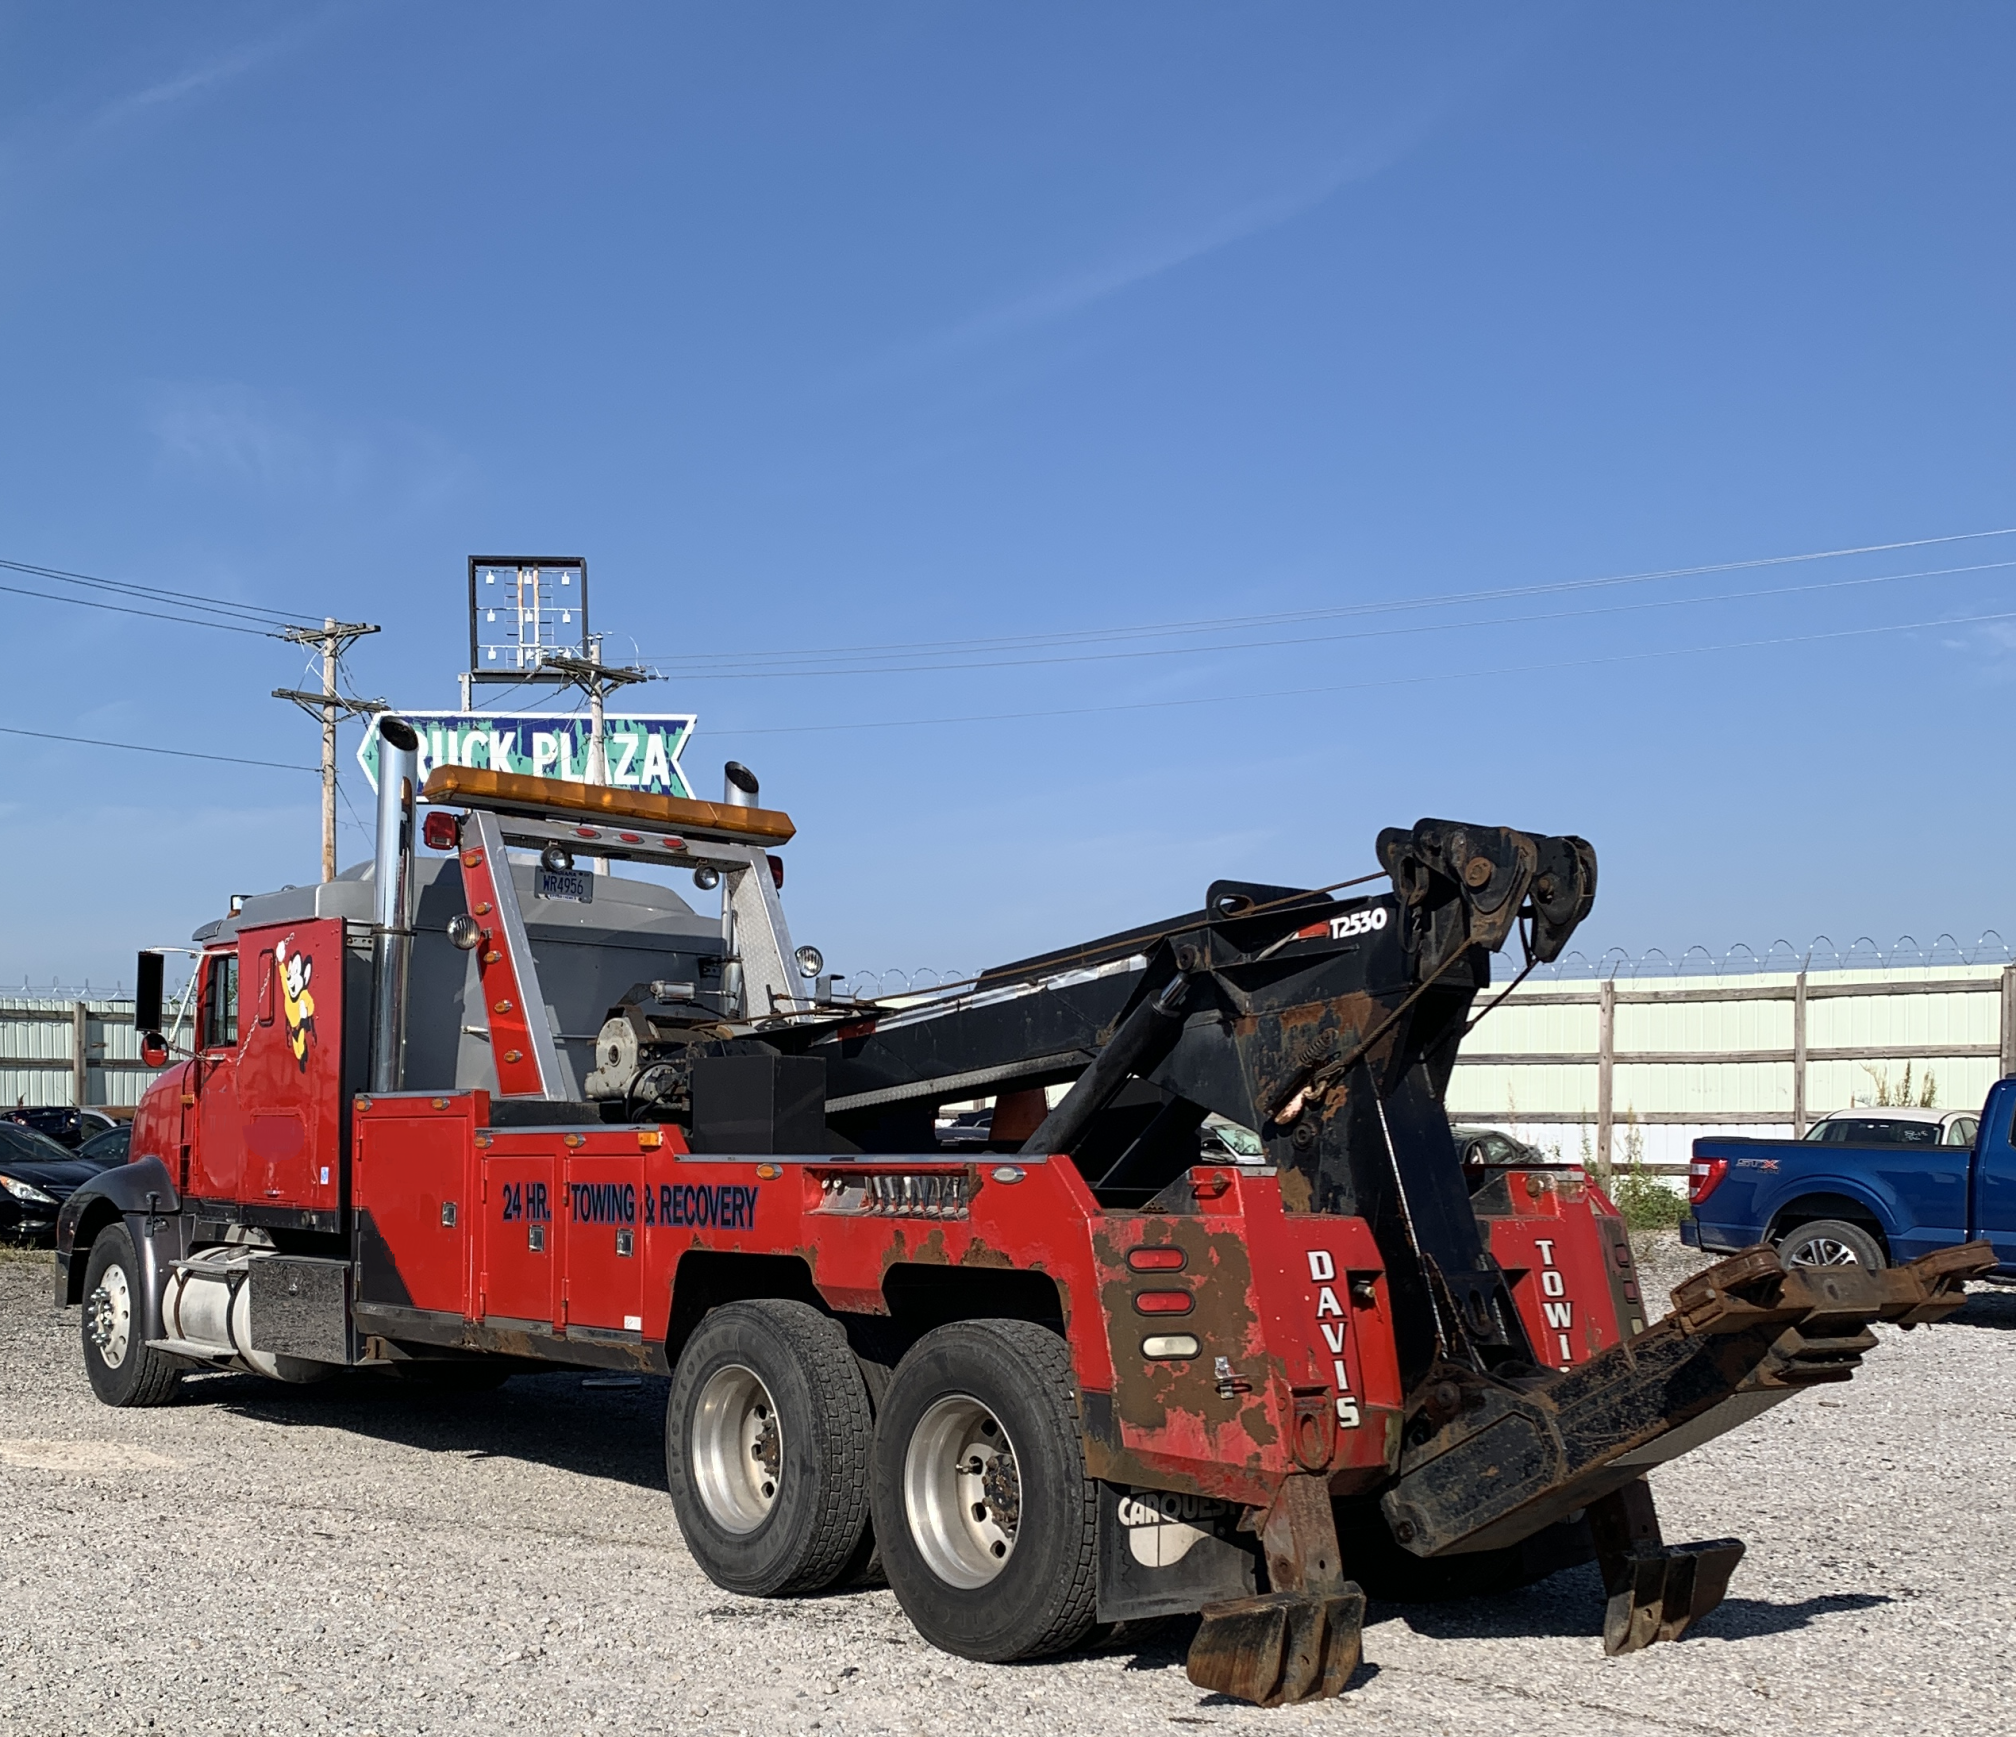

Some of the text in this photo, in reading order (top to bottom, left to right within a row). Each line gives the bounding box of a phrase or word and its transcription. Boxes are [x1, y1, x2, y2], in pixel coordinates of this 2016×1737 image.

[376, 731, 671, 786] RUCK PLAZA
[543, 875, 584, 895] WR4956
[1330, 907, 1387, 939] T2530
[502, 1182, 523, 1222] 24
[570, 1182, 635, 1224] TOWING
[640, 1183, 655, 1226] &
[660, 1183, 759, 1230] RECOVERY
[1534, 1239, 1576, 1373] TOWI
[1306, 1250, 1361, 1429] DAVIS
